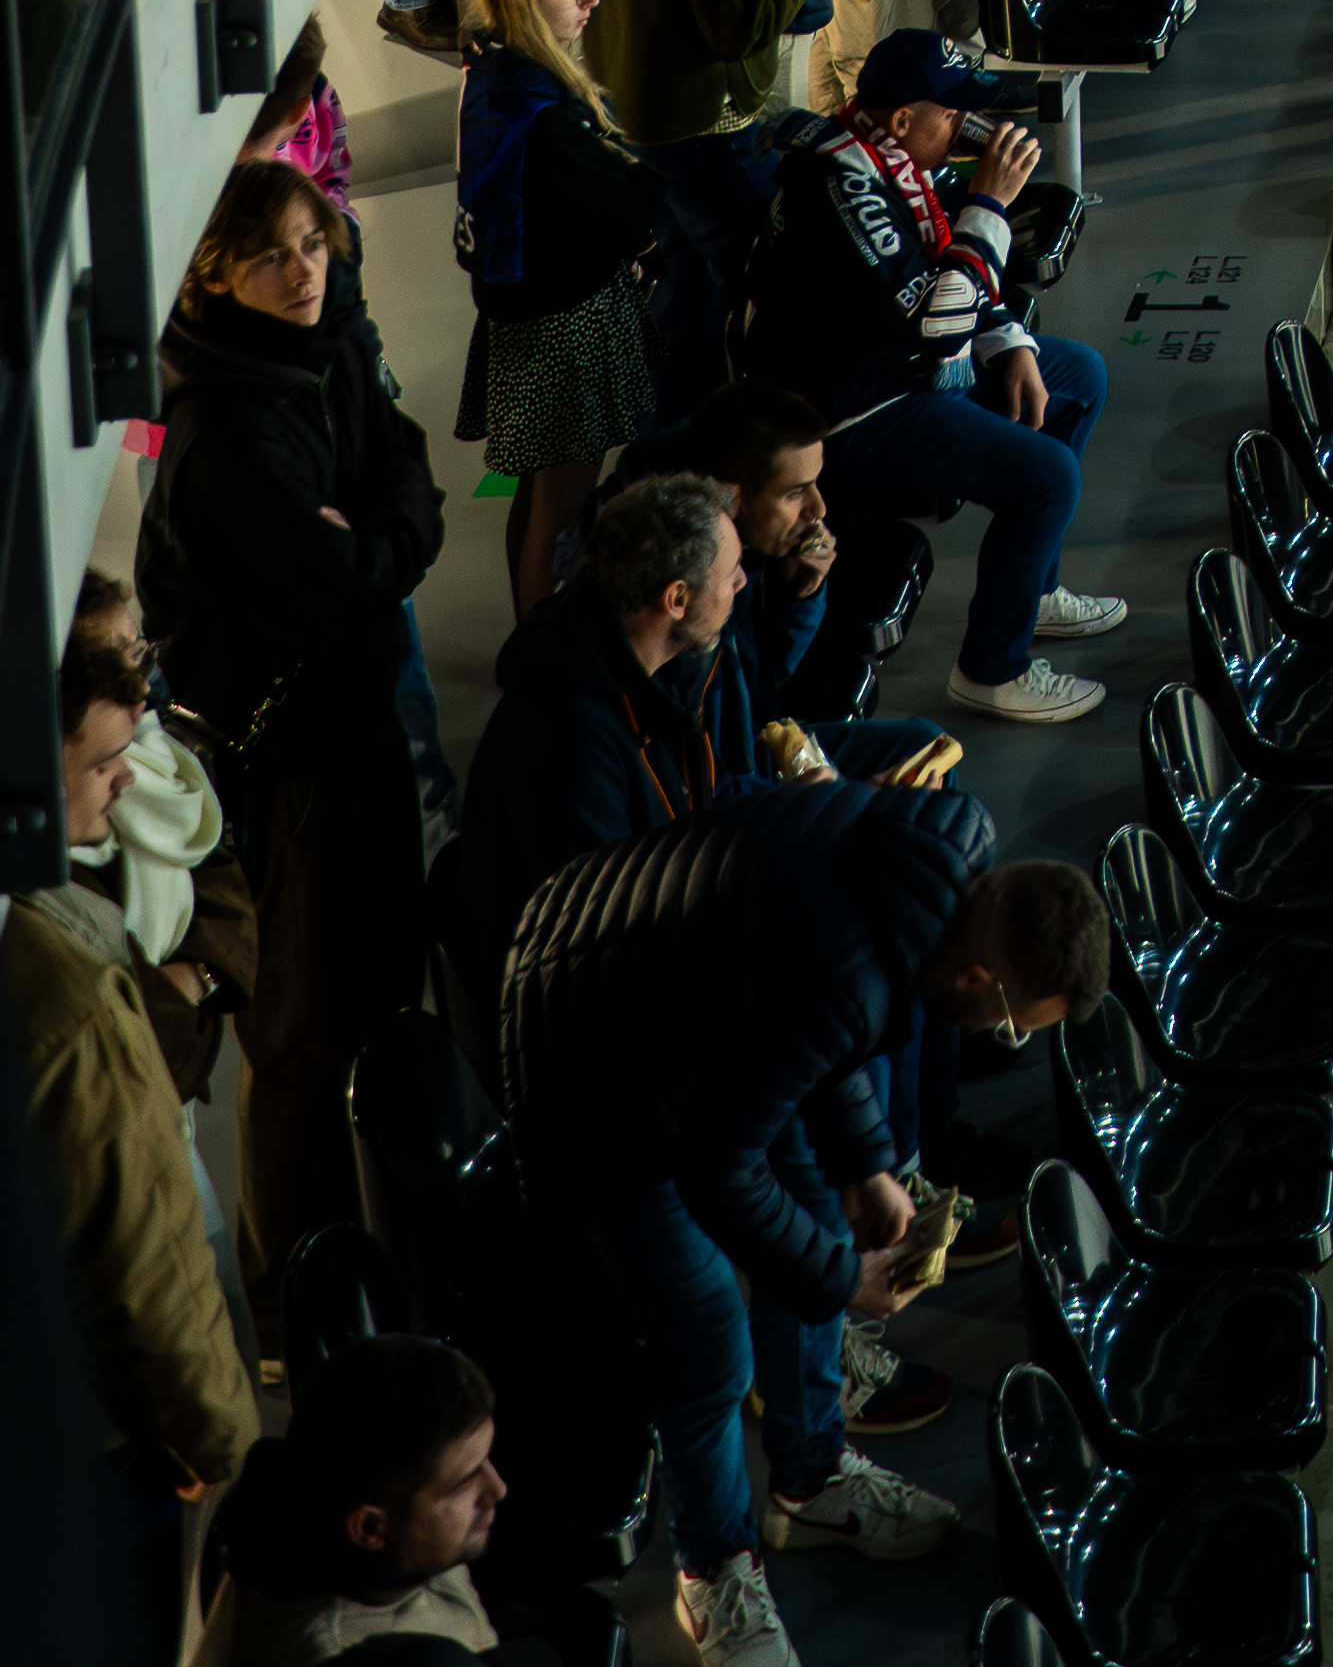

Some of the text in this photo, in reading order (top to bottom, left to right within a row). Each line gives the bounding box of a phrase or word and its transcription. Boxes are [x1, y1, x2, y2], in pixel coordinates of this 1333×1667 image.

[1185, 256, 1218, 284] L.124
[1217, 256, 1247, 283] L.121
[1123, 292, 1230, 322] 1
[1157, 331, 1190, 360] L.101
[1187, 331, 1220, 363] L.120
